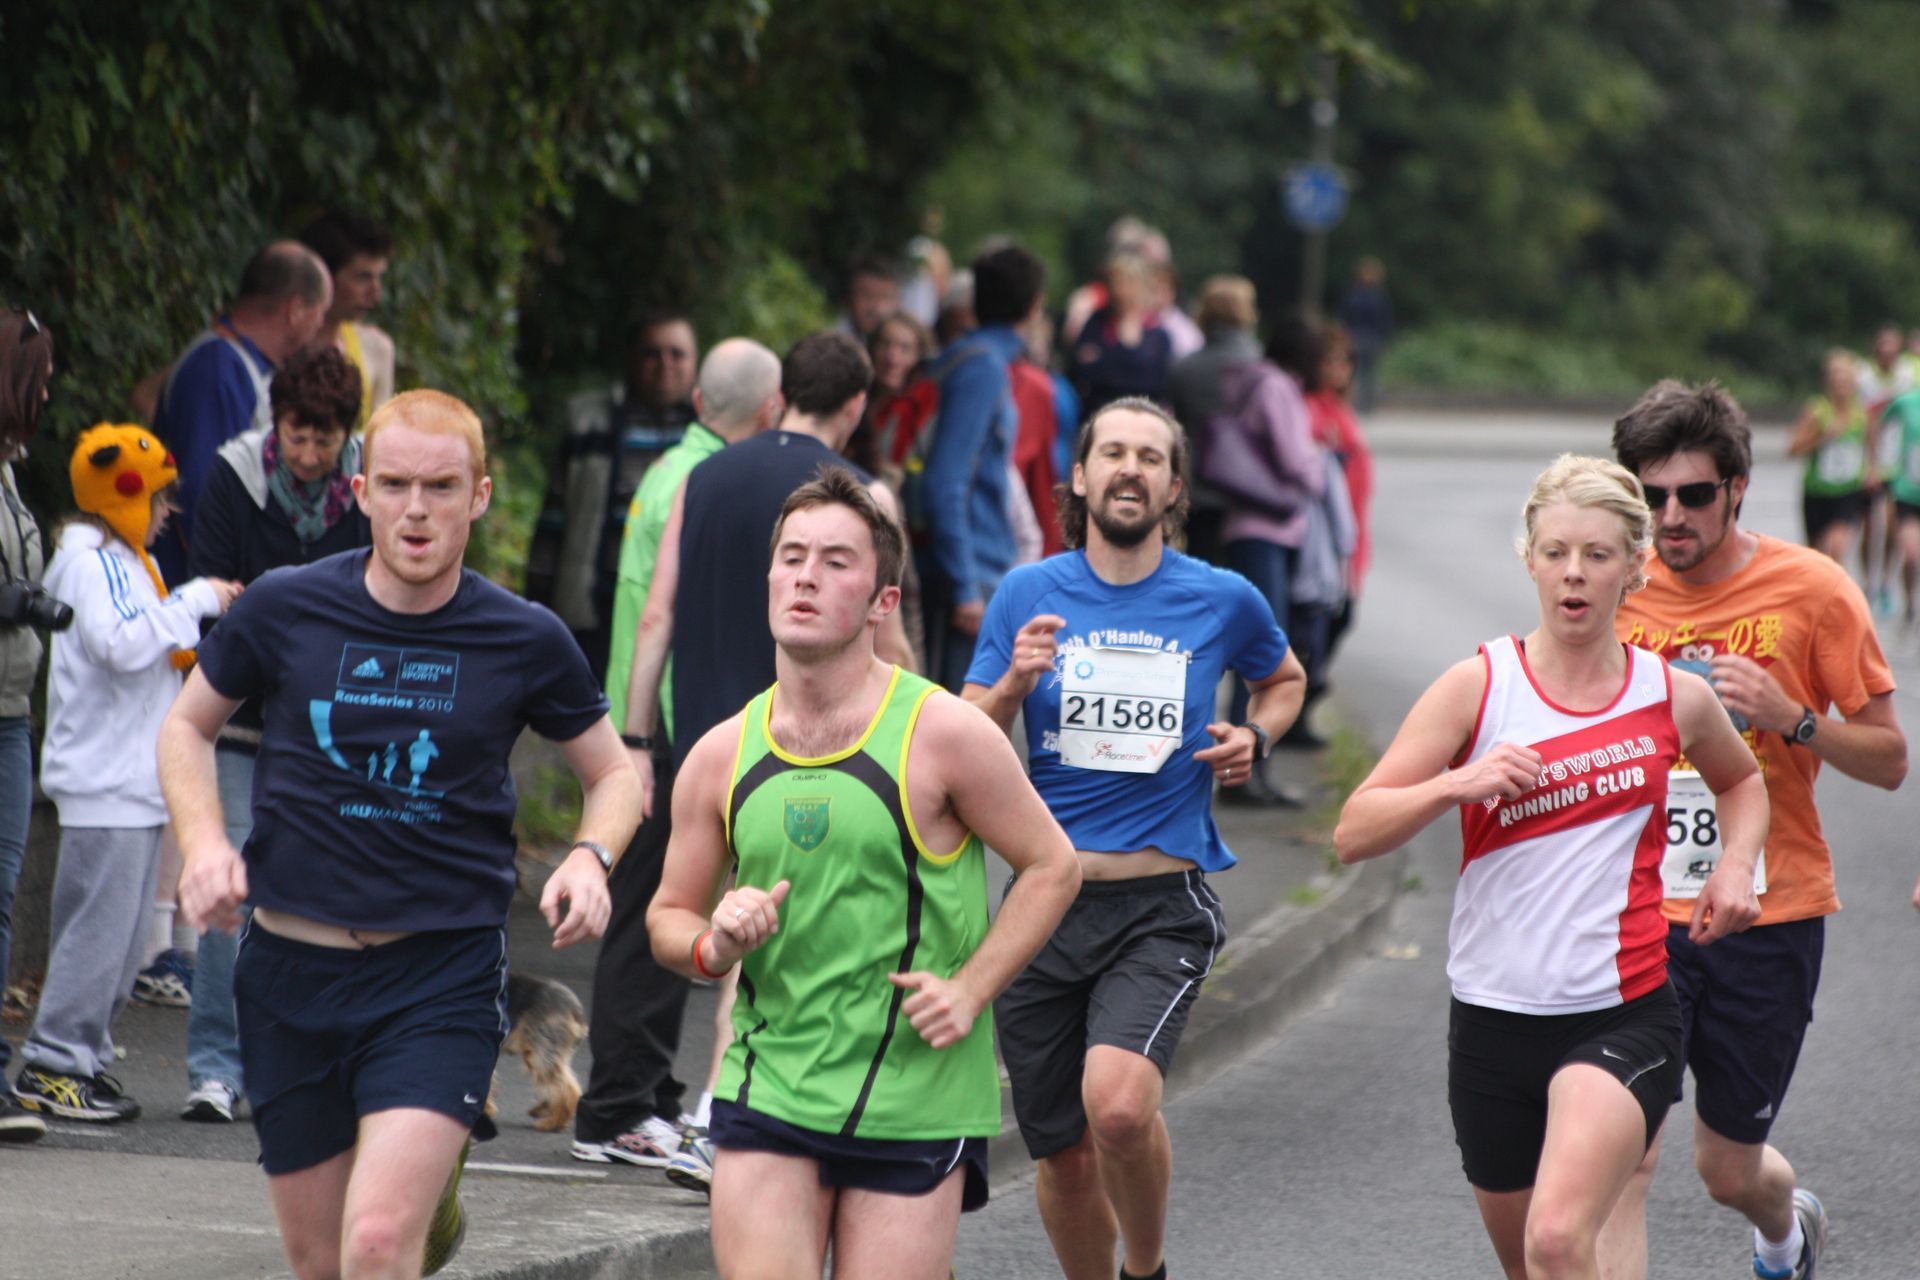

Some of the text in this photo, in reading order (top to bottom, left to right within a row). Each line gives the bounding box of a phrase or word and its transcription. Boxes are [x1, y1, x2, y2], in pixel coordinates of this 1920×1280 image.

[1089, 630, 1163, 649] O'Hanlon
[335, 689, 453, 713] RaceSeries 2010
[1065, 695, 1178, 732] 21586
[1500, 766, 1645, 827] RUNNING CLUB
